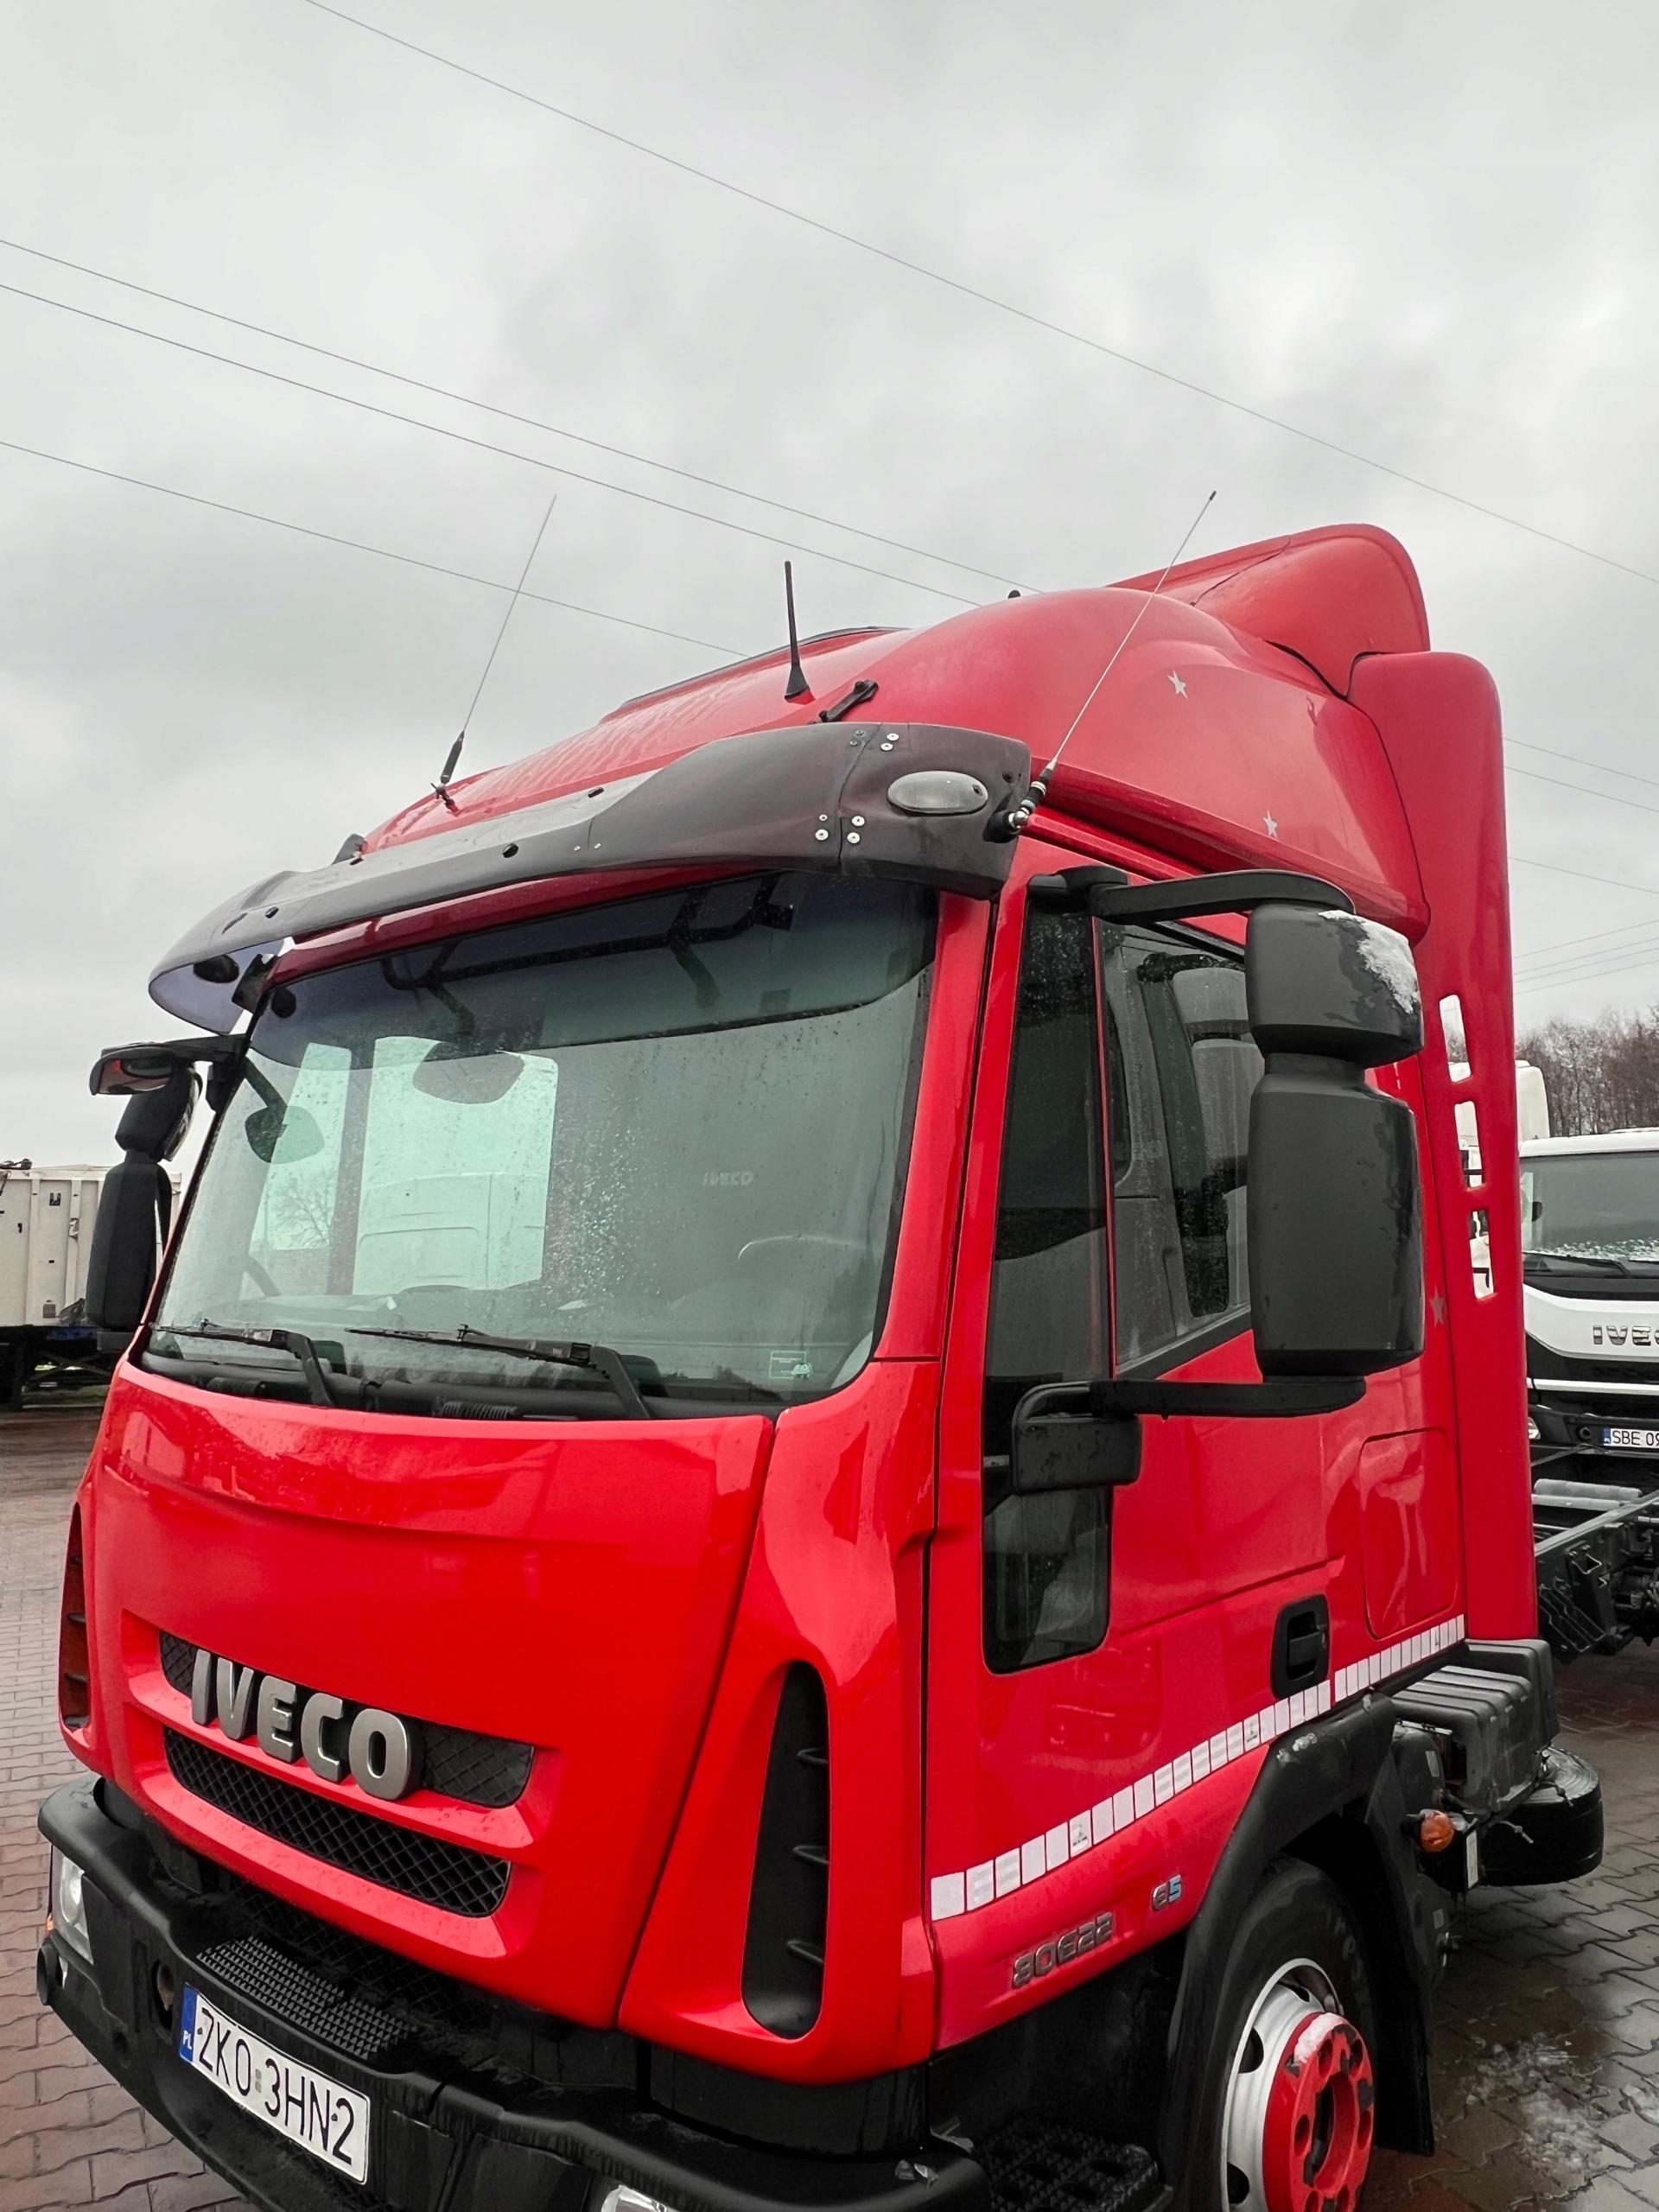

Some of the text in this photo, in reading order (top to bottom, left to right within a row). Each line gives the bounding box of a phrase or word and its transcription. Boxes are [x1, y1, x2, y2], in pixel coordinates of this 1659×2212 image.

[1592, 1325, 1659, 1346] IVE
[1612, 1430, 1641, 1446] SBE
[191, 1649, 413, 1801] IVECO
[1013, 1911, 1113, 1987] 80E22
[182, 2030, 193, 2050] PL
[199, 2007, 354, 2166] ZKO 3HN2
